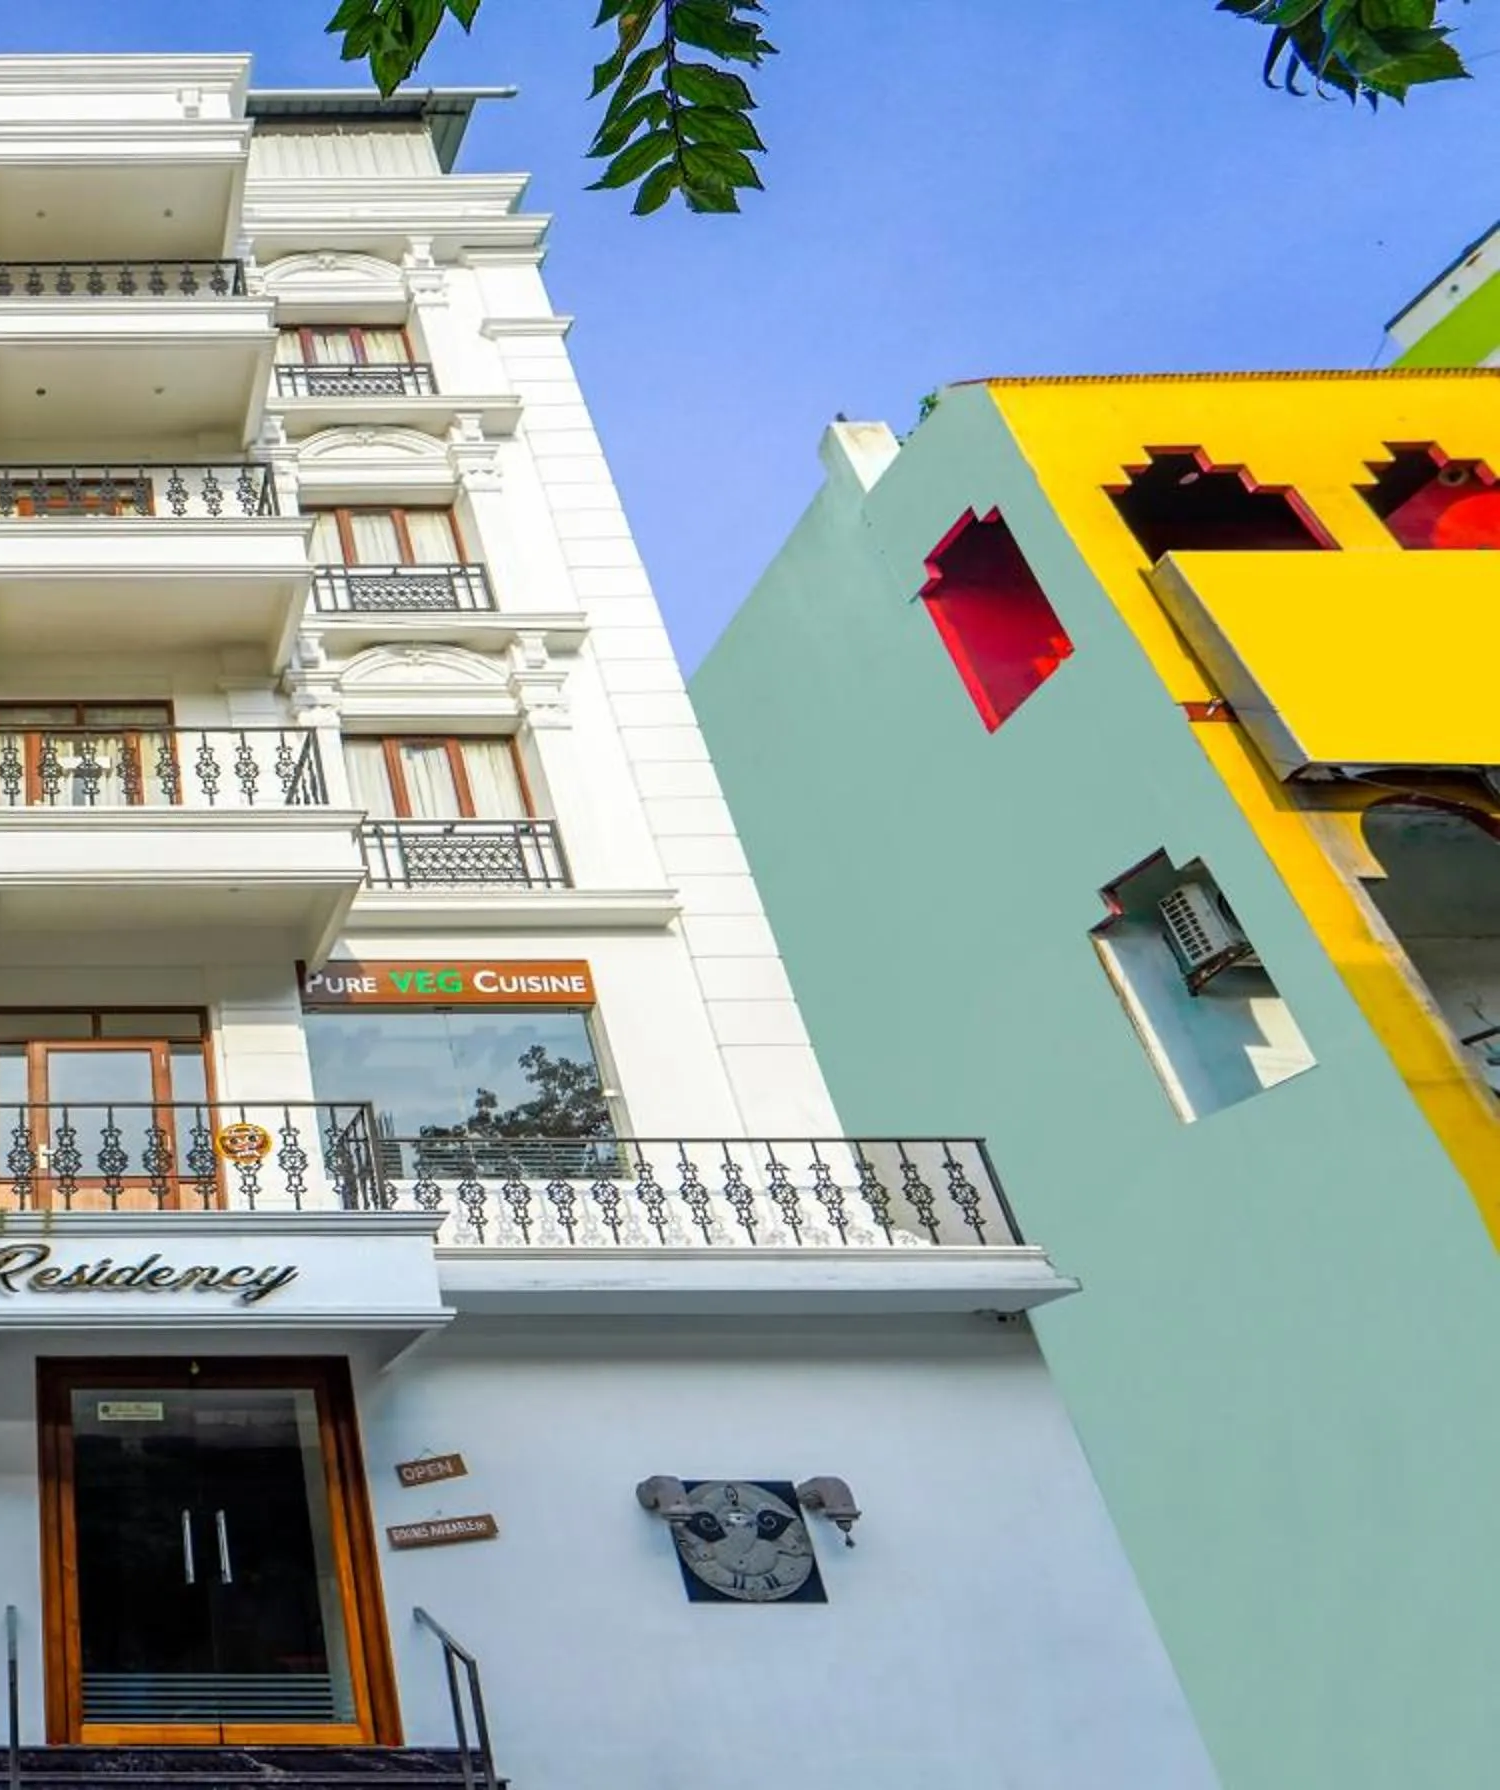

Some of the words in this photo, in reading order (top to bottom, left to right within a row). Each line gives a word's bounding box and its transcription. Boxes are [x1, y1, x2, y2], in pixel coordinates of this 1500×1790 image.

[305, 974, 378, 993] PURE
[389, 968, 463, 993] VEG
[473, 970, 587, 993] CUISINE
[402, 1461, 454, 1480] OPEN
